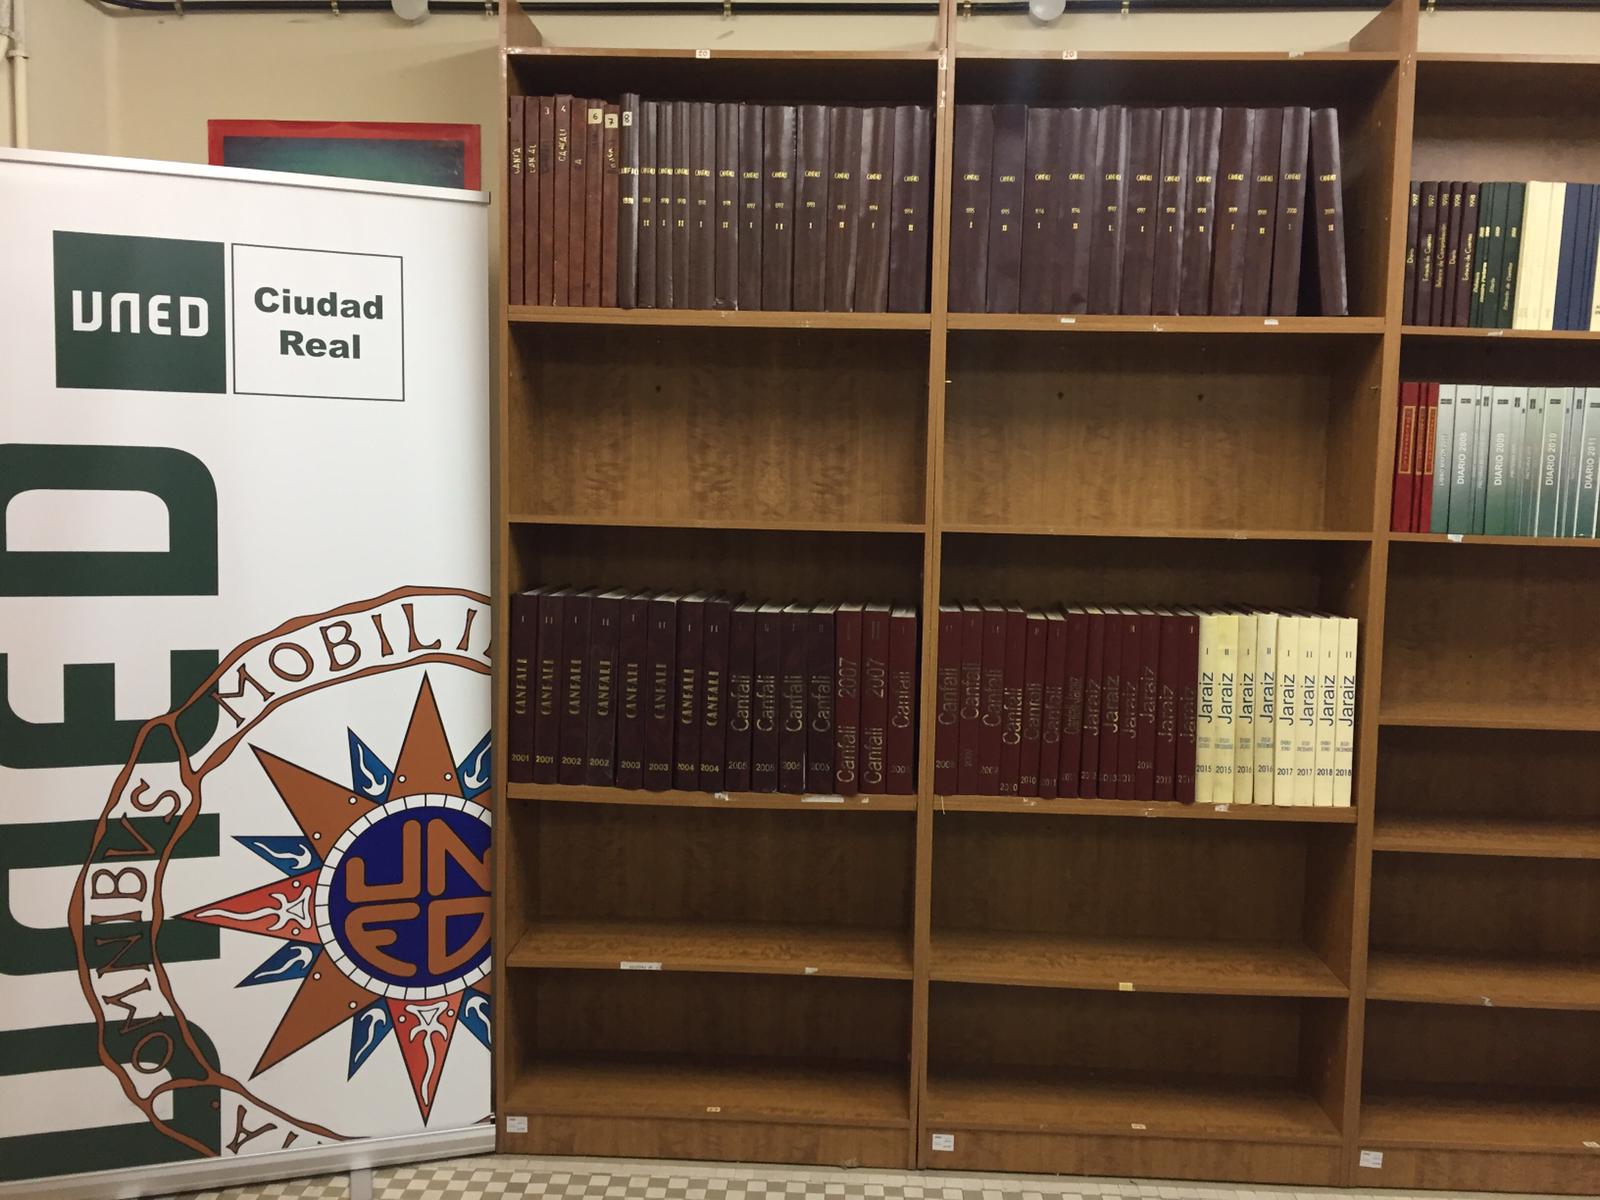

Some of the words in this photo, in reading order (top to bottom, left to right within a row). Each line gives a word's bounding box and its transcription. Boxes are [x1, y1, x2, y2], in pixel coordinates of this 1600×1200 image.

[72, 290, 208, 337] UNED
[254, 286, 384, 320] Ciudad
[280, 330, 361, 360] Real
[1548, 432, 1558, 452] 2010
[1588, 437, 1596, 456] 2011
[1456, 453, 1466, 484] DIARIO
[1494, 454, 1504, 486] DIARIO
[1546, 454, 1556, 486] DIARIO
[1584, 457, 1594, 489] DIARIO
[210, 604, 491, 728] MOBILI
[515, 658, 528, 715] CANFALI
[540, 660, 554, 716] CANFALI
[568, 660, 582, 715] CANFALI
[597, 660, 611, 716] CANFALI
[626, 664, 638, 719] CANFALI
[654, 664, 668, 720] CANFALI
[838, 657, 857, 698] 2007
[866, 658, 886, 698] 2007
[681, 668, 695, 724] CANFALI
[706, 670, 720, 726] CANFALI
[731, 674, 751, 732] Canfali
[756, 674, 776, 732] Canfali
[784, 674, 803, 732] Canfali
[812, 674, 831, 732] Canfali
[938, 668, 958, 726] Canfali
[982, 668, 1002, 727] Canfali
[1002, 687, 1022, 745] Canfali
[1198, 672, 1214, 724] Jaraiz
[1218, 672, 1234, 725] Jaraiz
[1239, 672, 1254, 724] Jaraiz
[1260, 672, 1275, 724] Jaraiz
[1279, 674, 1296, 726] Jaraiz
[1300, 674, 1316, 727] Jaraiz
[1319, 674, 1336, 726] Jaraiz
[1338, 675, 1355, 727] Jaraiz
[512, 754, 530, 763] 2001
[536, 755, 554, 764] 2001
[562, 756, 582, 766] 2002
[590, 758, 610, 767] 2002
[621, 760, 641, 770] 2003
[649, 763, 669, 772] 2003
[677, 763, 694, 772] 2004
[700, 764, 720, 773] 2004
[836, 725, 856, 783] Canfali
[863, 727, 883, 784] Canfali
[1196, 764, 1212, 773] 2015
[1215, 766, 1232, 774] 2015
[1277, 768, 1294, 776] 2017
[1296, 768, 1312, 777] 2017
[1316, 768, 1334, 777] 2018
[1335, 768, 1352, 777] 2018
